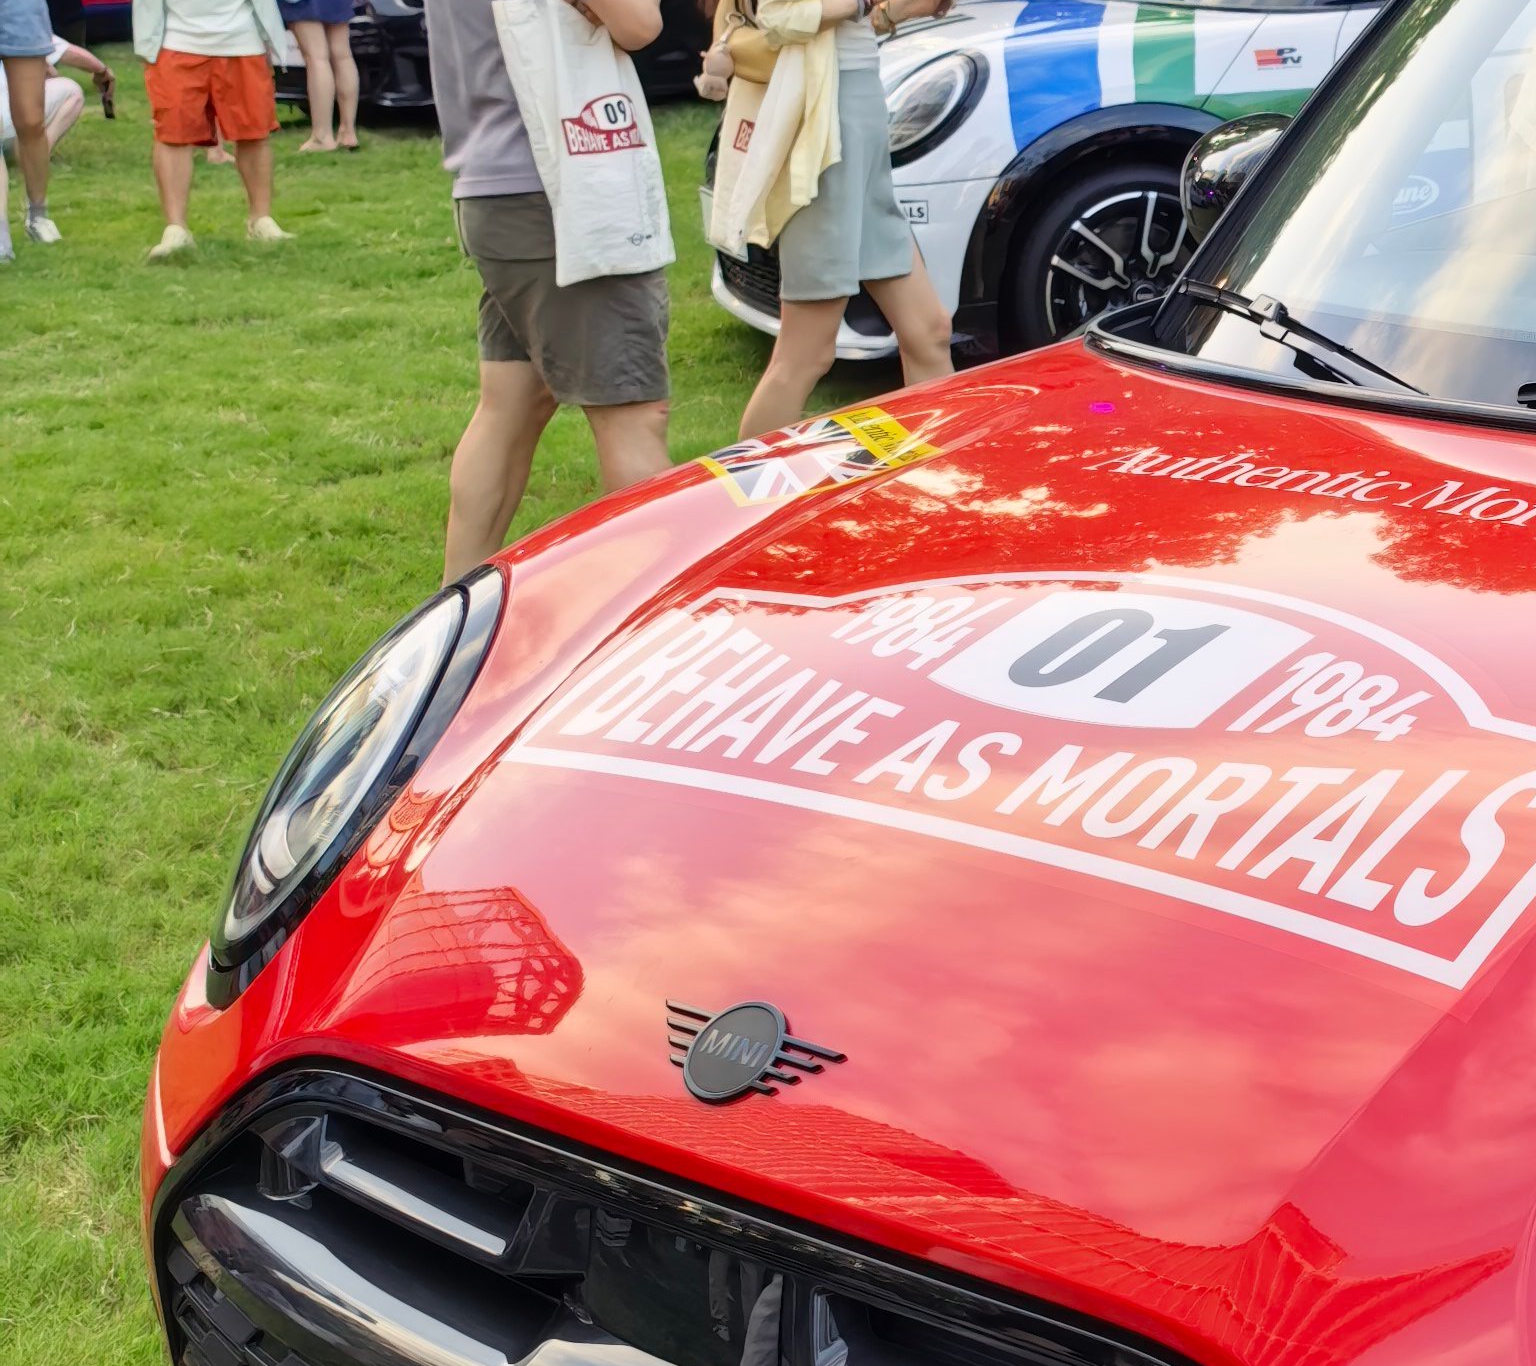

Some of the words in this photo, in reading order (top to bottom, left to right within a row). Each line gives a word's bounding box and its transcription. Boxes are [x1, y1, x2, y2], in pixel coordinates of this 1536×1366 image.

[564, 120, 611, 154] BEHAVE
[612, 132, 631, 148] AS
[604, 100, 627, 125] 09
[1083, 445, 1412, 503] Authentic
[1008, 608, 1232, 704] 01
[560, 606, 906, 777] BEHAVE
[851, 719, 1023, 801] AS
[1226, 651, 1434, 742] 1984
[699, 1028, 769, 1068] MINI
